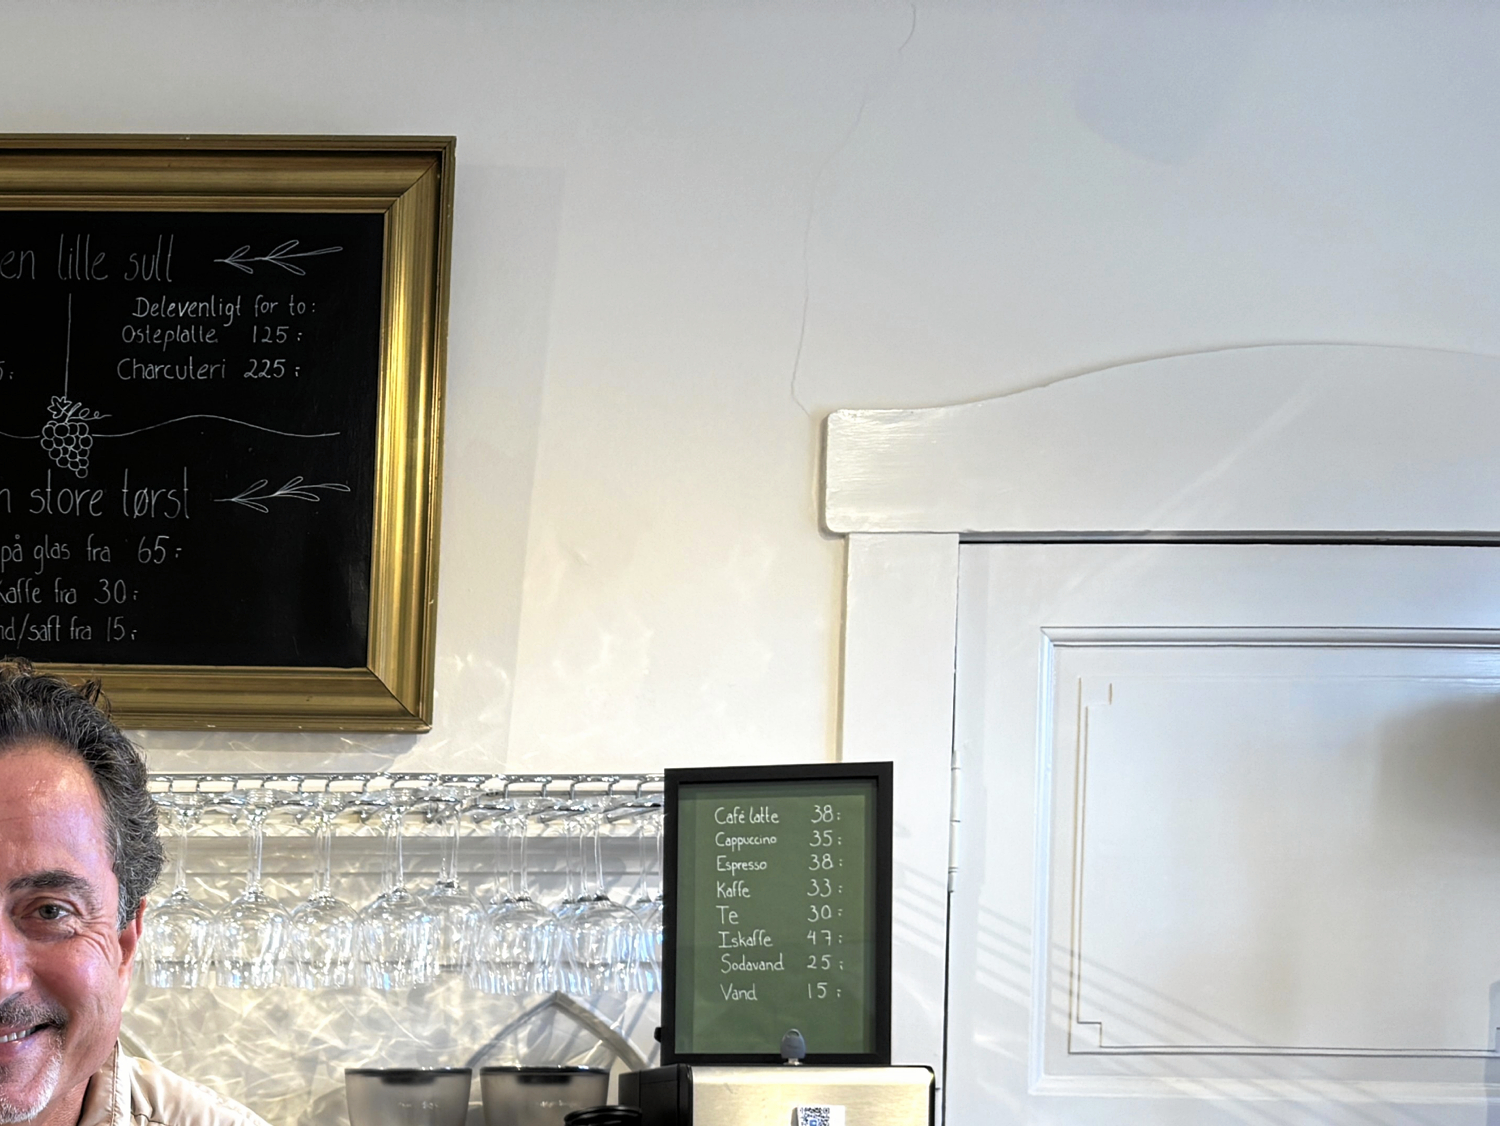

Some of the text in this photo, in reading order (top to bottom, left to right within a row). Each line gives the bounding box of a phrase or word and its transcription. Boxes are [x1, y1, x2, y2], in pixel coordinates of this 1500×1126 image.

[57, 232, 109, 281] lille
[254, 293, 279, 318] for
[116, 355, 226, 381] Charcuteri
[28, 467, 105, 517] store
[121, 466, 190, 520] tørst
[0, 533, 24, 574] på
[32, 533, 71, 576] glas
[85, 532, 112, 564] fra
[53, 576, 78, 605] fra
[69, 615, 93, 642] fra
[714, 806, 746, 825] Café
[749, 806, 780, 824] latte
[714, 831, 777, 852] Cappuccino
[716, 854, 768, 877] Espresso
[716, 880, 751, 899] Kaffe
[715, 905, 740, 925] Te
[717, 929, 774, 949] Iskaffe
[720, 952, 785, 974] Sodavand
[720, 983, 758, 1001] Vand
